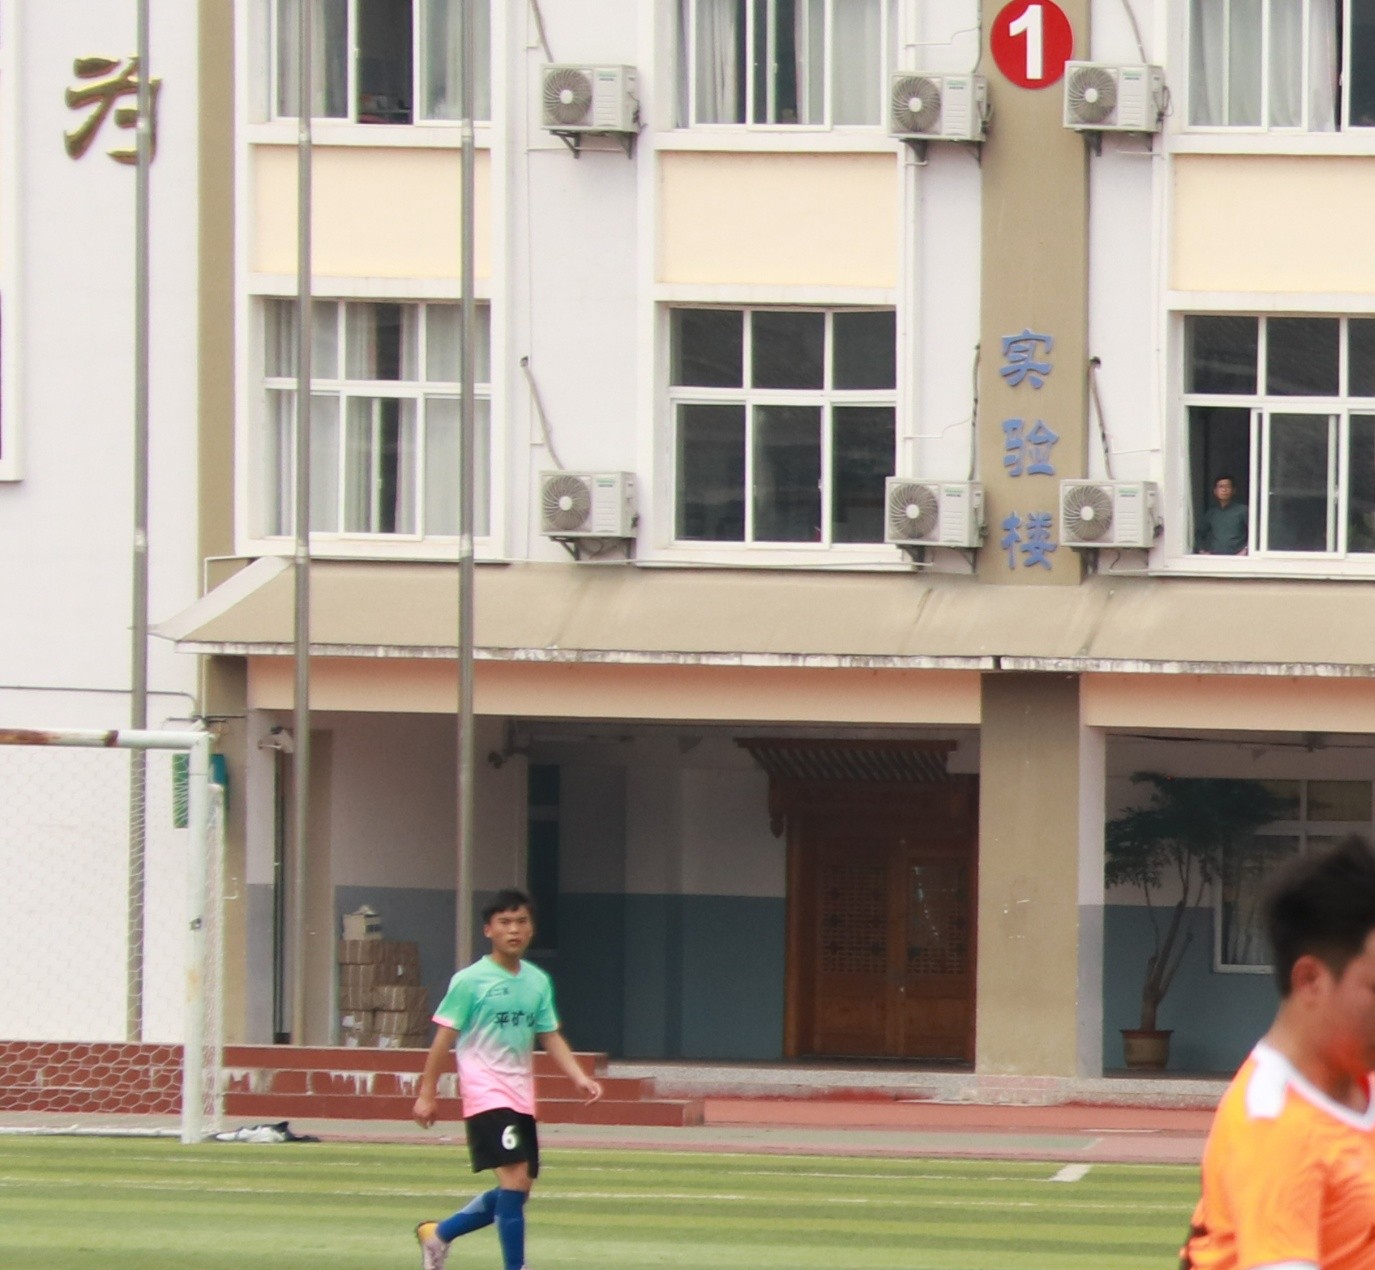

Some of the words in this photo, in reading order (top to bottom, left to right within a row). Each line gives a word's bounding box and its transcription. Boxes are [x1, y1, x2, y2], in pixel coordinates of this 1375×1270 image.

[1008, 4, 1045, 80] 1
[1000, 328, 1060, 571] 实验楼
[501, 1124, 518, 1151] 6
